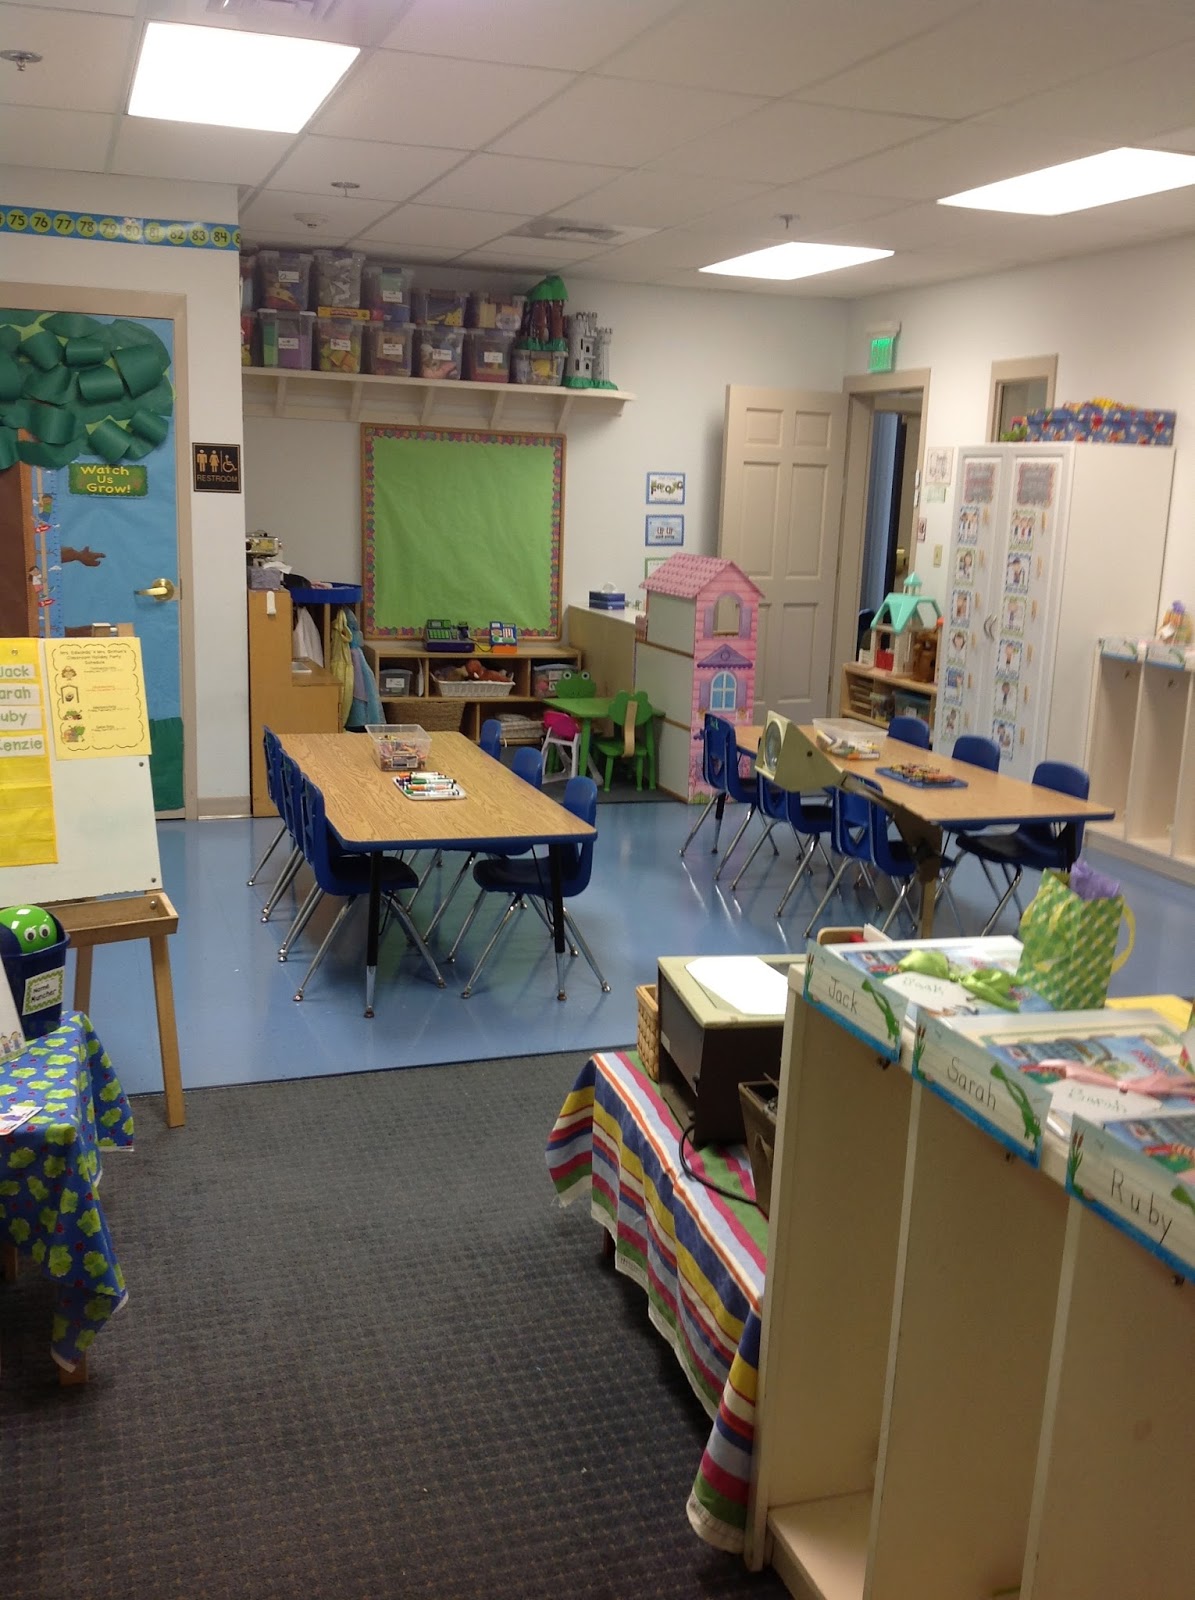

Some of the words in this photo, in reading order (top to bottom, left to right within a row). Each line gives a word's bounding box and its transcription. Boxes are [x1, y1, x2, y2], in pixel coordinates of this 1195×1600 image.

[10, 214, 25, 226] 75
[34, 216, 48, 228] 76
[57, 218, 72, 230] 77
[80, 220, 94, 232] 78
[103, 223, 117, 235] 79
[125, 225, 140, 236] 80
[170, 228, 184, 240] 82
[191, 230, 206, 241] 83
[213, 231, 227, 243] 84
[80, 466, 130, 476] Watch
[96, 475, 114, 484] Us
[196, 474, 238, 483] RESTROOM
[86, 483, 131, 493] Grow!
[0, 686, 31, 700] arah
[0, 710, 28, 726] uby
[0, 738, 43, 752] enzie
[828, 976, 858, 1014] Jack
[947, 1056, 997, 1111] Sarah
[1111, 1168, 1173, 1245] Ruby
